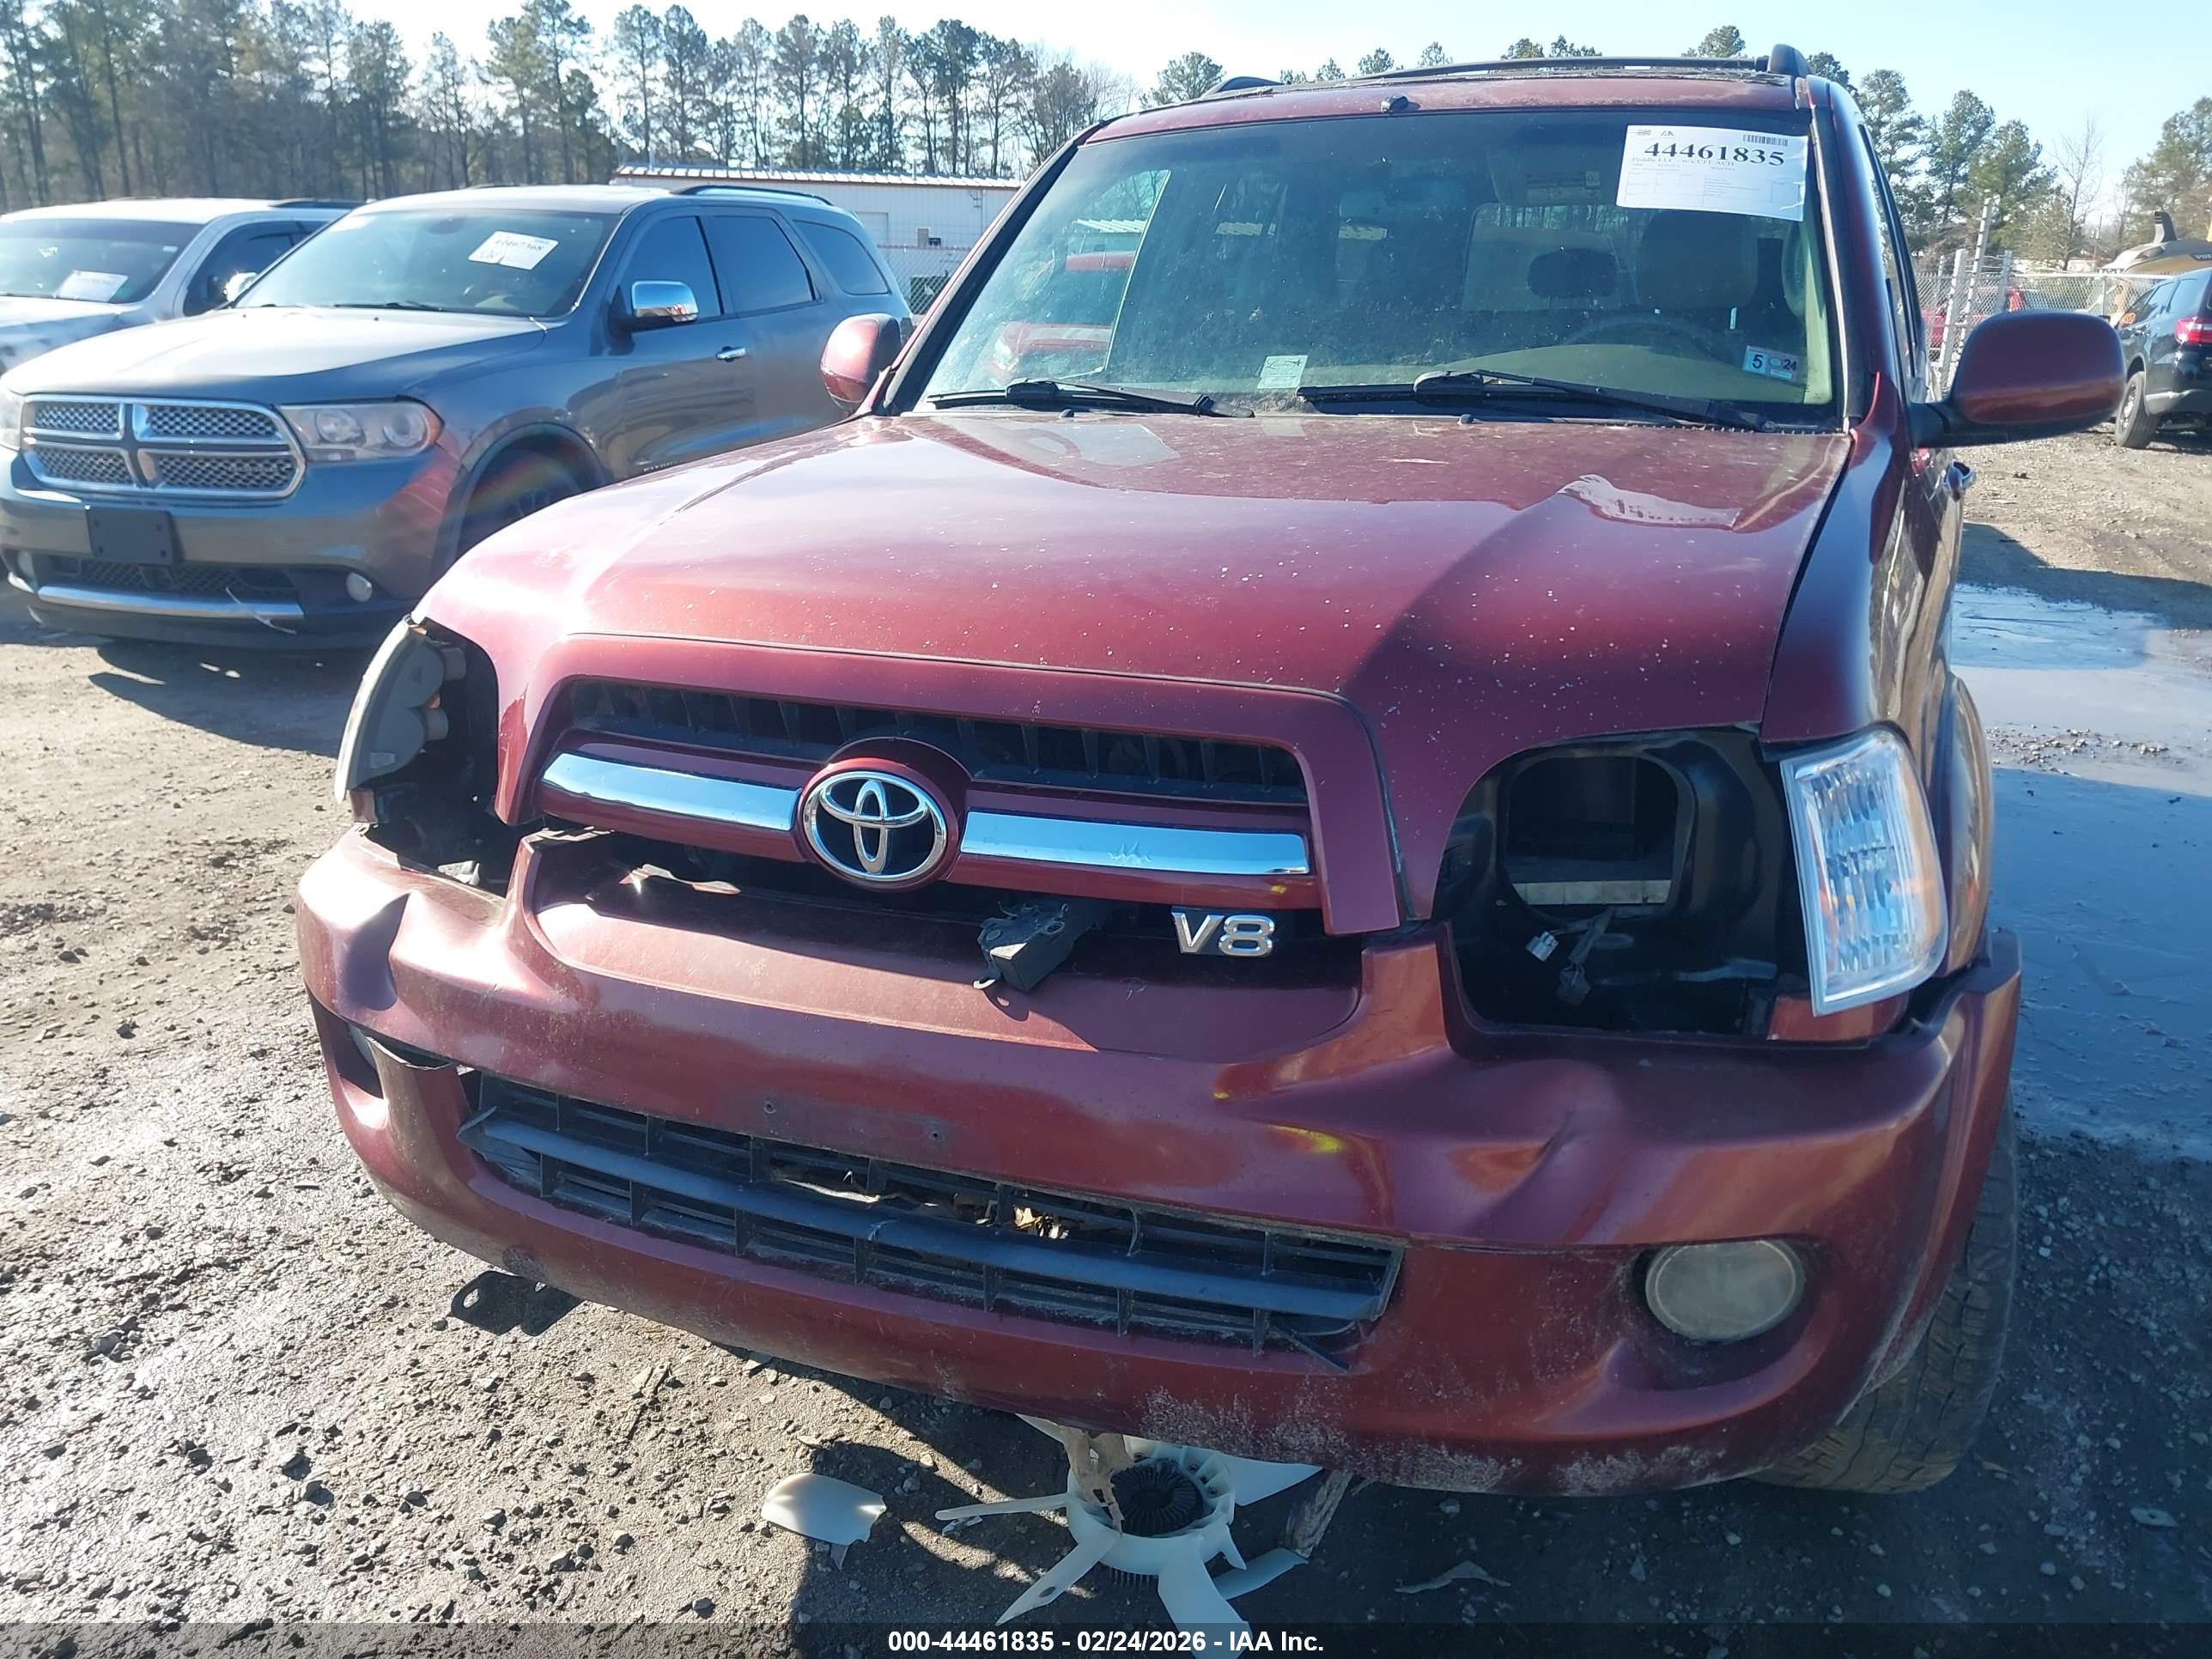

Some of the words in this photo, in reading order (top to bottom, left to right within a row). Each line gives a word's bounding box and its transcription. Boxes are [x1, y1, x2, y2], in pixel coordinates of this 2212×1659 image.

[1644, 142, 1784, 167] 44461835
[1752, 354, 1763, 369] 5
[1782, 358, 1797, 372] 24
[1170, 910, 1275, 957] V8
